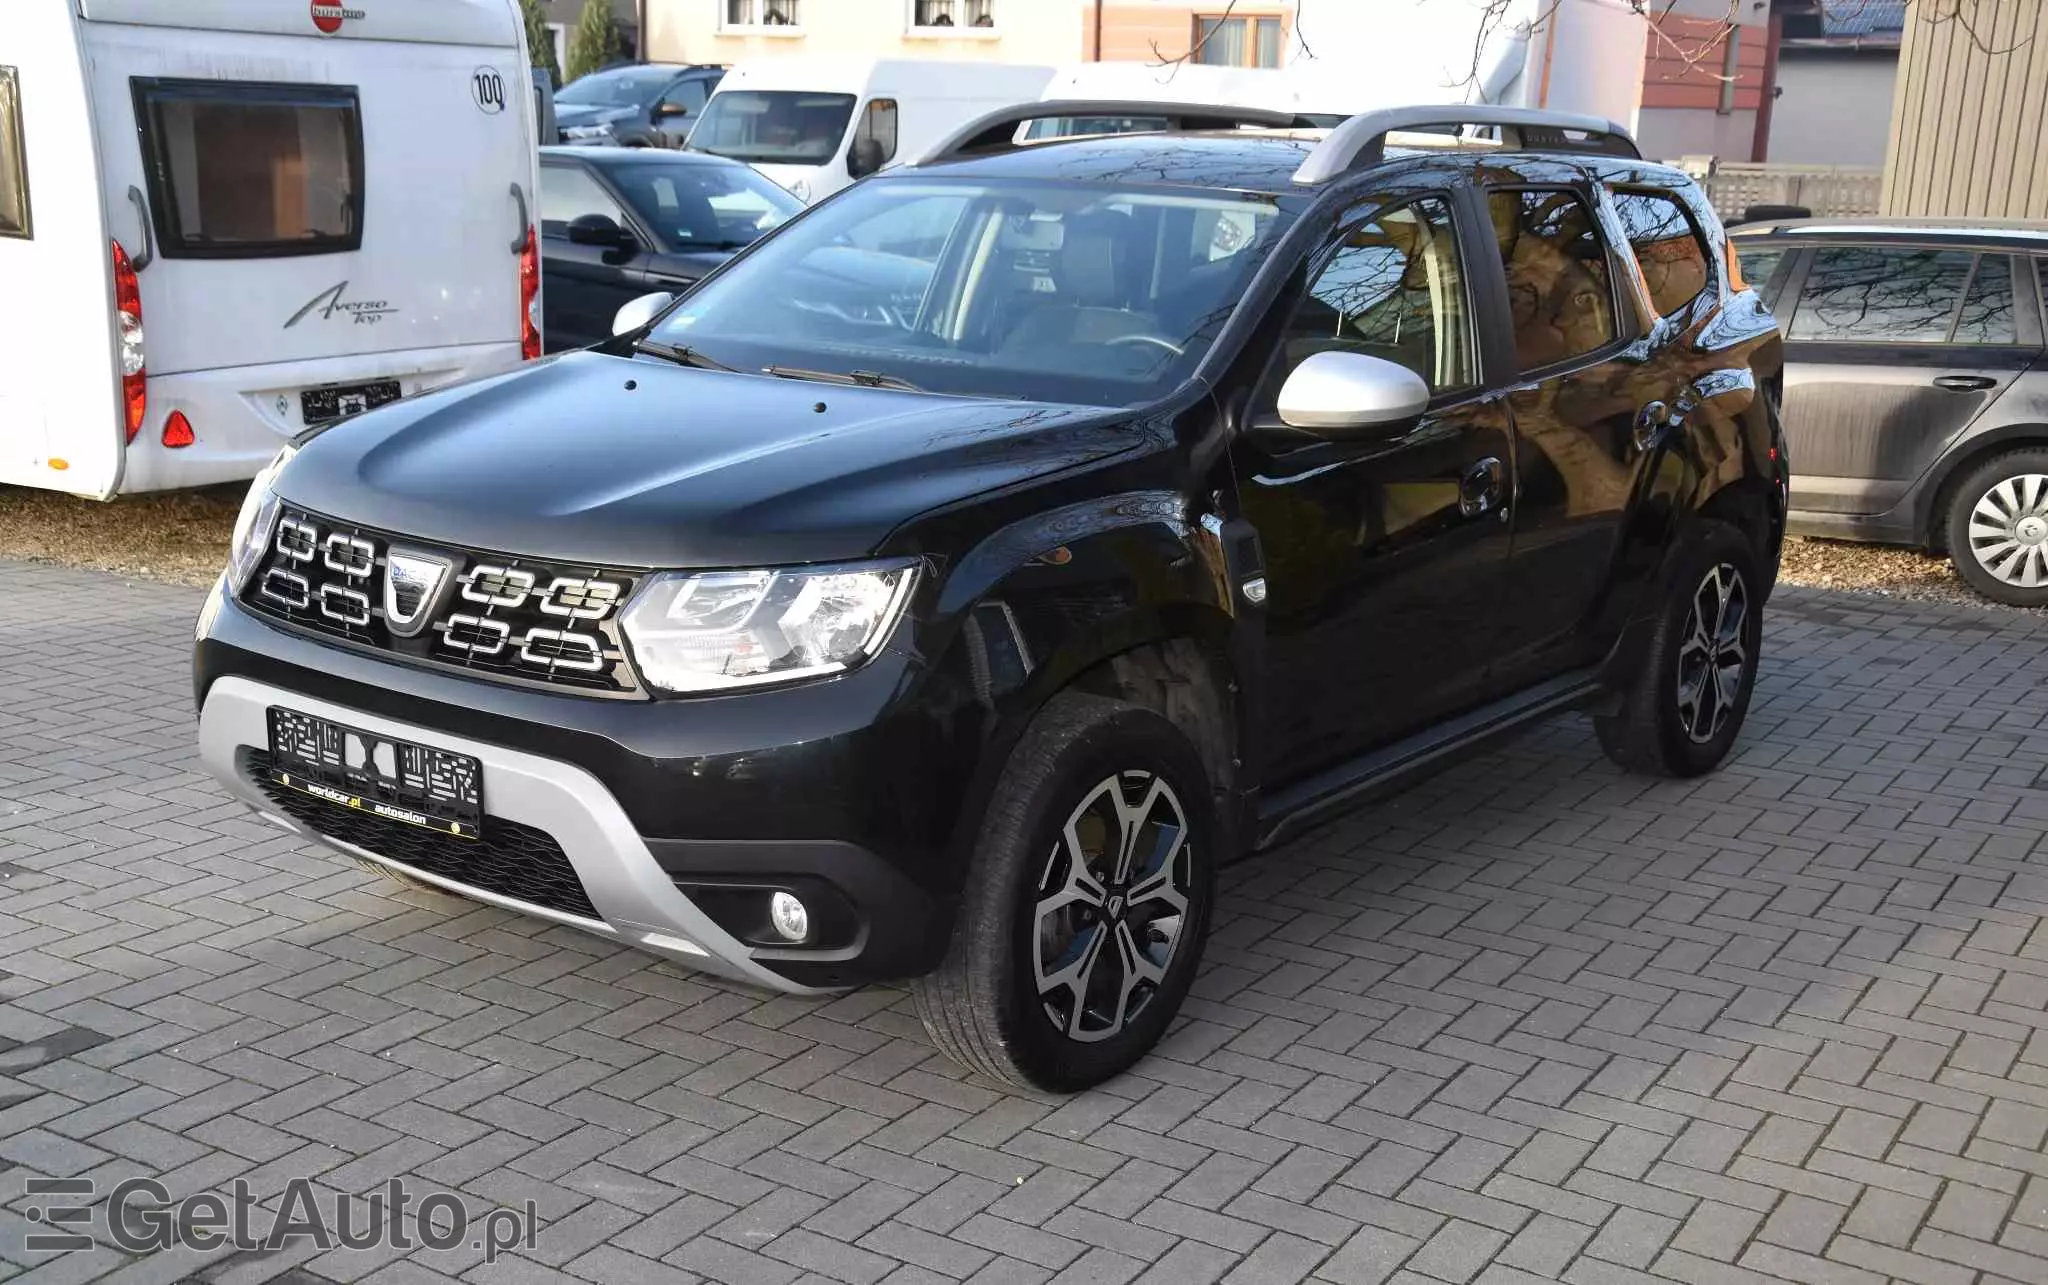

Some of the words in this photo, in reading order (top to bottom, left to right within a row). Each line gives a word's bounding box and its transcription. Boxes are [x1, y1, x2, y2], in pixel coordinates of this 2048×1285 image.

[474, 74, 503, 105] 100
[283, 280, 388, 328] Averso
[308, 784, 361, 807] worldcar.pl
[375, 804, 426, 825] autosalon
